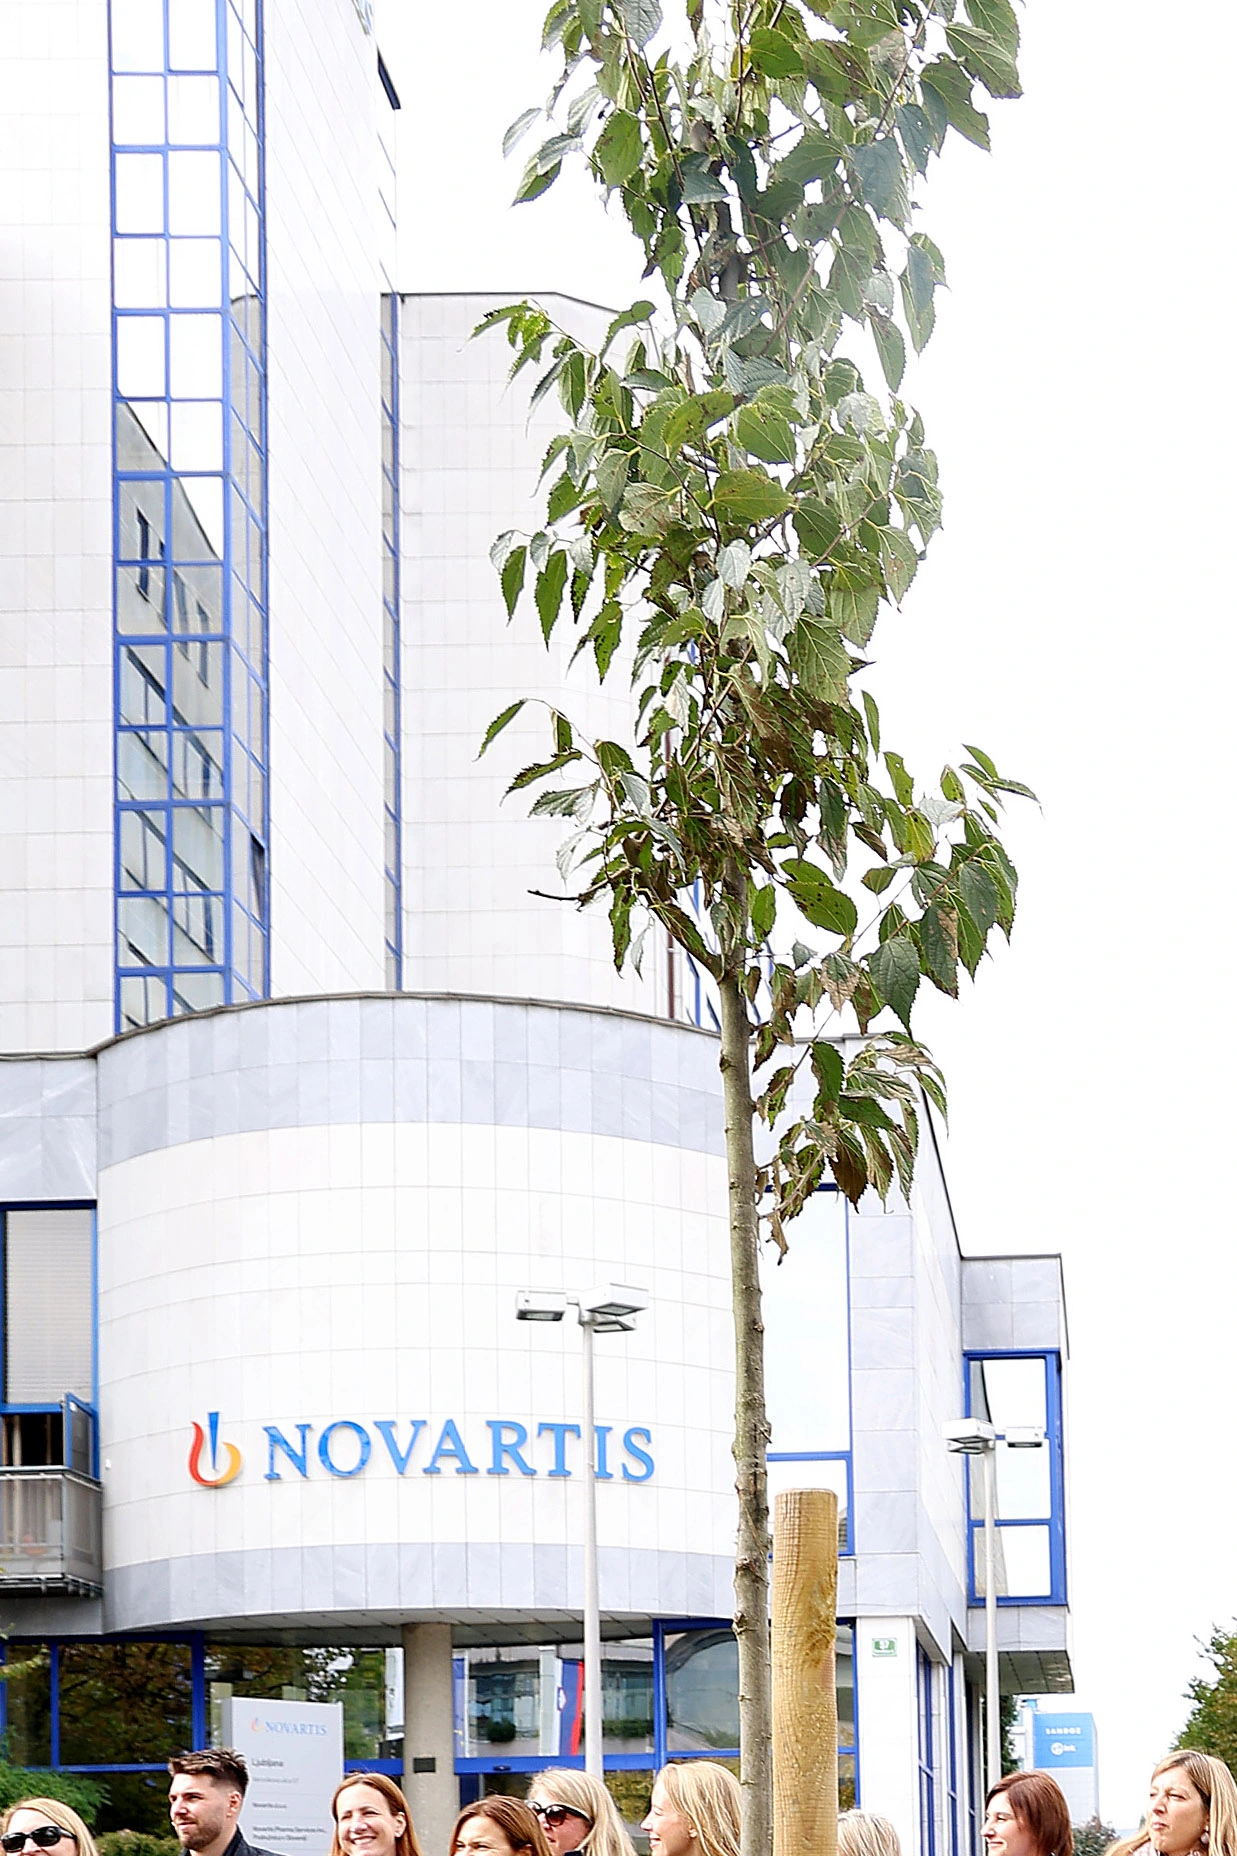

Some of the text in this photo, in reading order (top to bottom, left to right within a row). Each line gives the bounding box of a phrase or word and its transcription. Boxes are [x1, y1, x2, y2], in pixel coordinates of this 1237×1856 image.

[262, 1418, 656, 1482] NOVARTIS
[265, 1721, 327, 1736] NOVARTIS
[1045, 1726, 1081, 1735] SANDOZ
